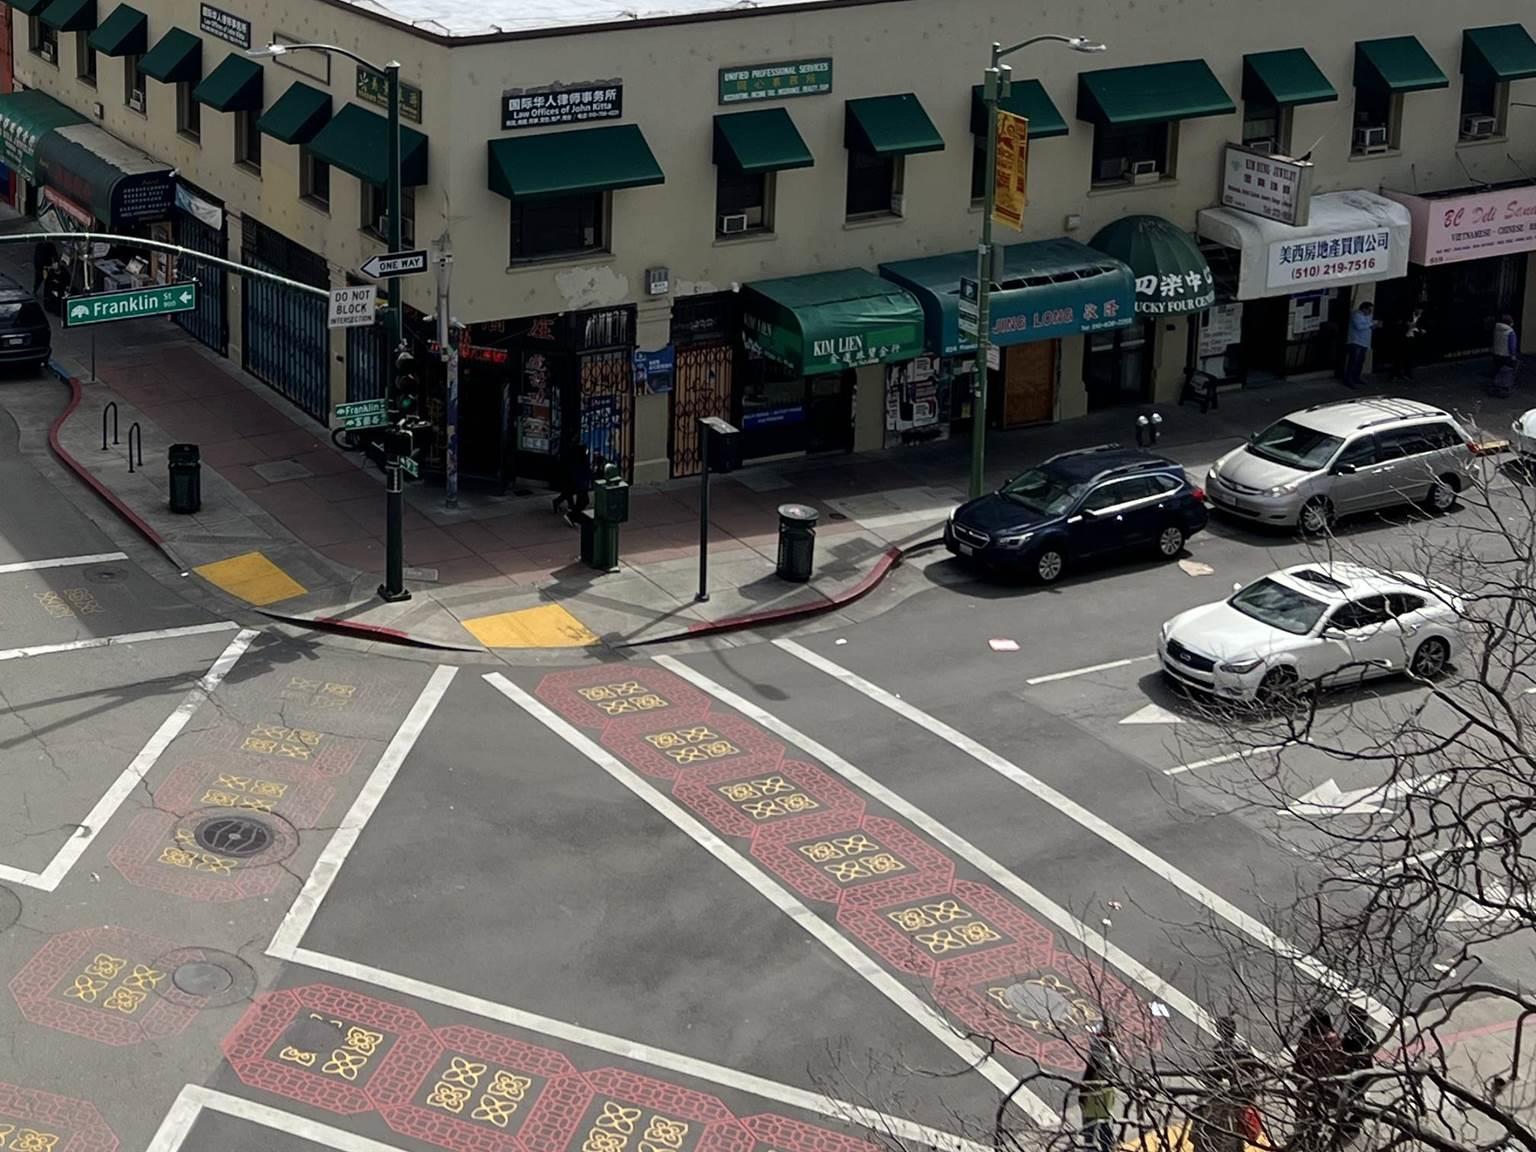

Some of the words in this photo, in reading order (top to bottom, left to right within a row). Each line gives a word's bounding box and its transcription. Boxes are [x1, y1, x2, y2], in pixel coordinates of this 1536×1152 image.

[798, 63, 829, 73] SERVICES
[509, 89, 617, 111] 国际华人律师事务所
[513, 111, 530, 119] Law
[531, 107, 559, 117] Offices
[561, 105, 570, 113] of
[571, 104, 591, 113] John
[1280, 232, 1389, 265] 美西房地產買賣公司
[379, 261, 399, 271] ONE
[401, 258, 421, 268] WAY
[1291, 266, 1320, 280] (510)
[1323, 258, 1376, 275] 219-7516
[335, 292, 348, 302] DO
[352, 290, 370, 301] NOT
[94, 295, 158, 316] Franklin
[163, 291, 172, 300] St
[336, 304, 367, 315] BLOCK
[1134, 302, 1165, 313] UCKY
[1167, 299, 1196, 312] FOUR
[330, 315, 372, 325] INTERSECTION
[1033, 307, 1074, 328] LONG
[813, 339, 834, 356] KIM
[838, 335, 863, 353] LIEN
[346, 403, 380, 415] Franklin
